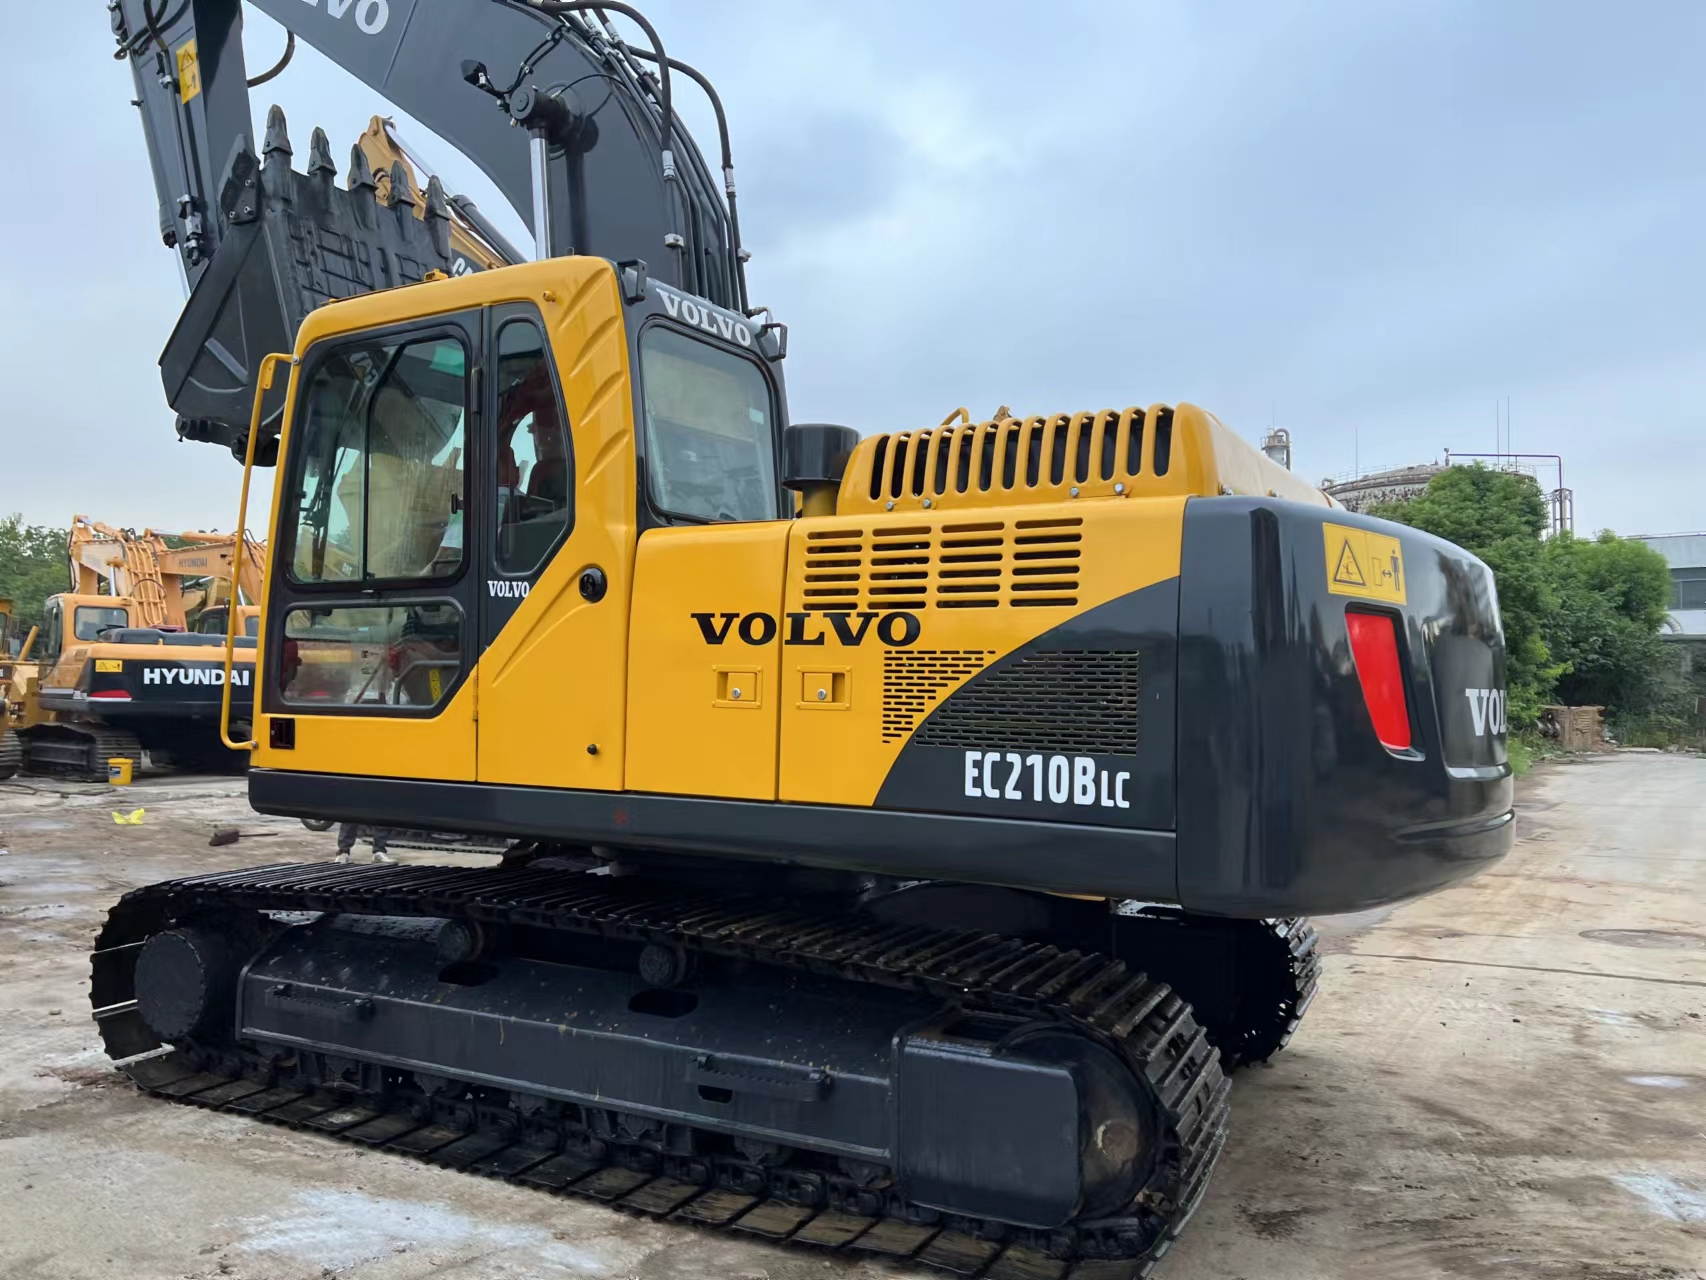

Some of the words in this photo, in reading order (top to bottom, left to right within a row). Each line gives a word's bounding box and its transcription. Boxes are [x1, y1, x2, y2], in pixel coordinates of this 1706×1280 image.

[655, 288, 751, 347] VOLVO
[487, 580, 530, 598] VOLVO
[690, 611, 922, 647] VOLVO
[144, 668, 249, 686] HYUNDAI
